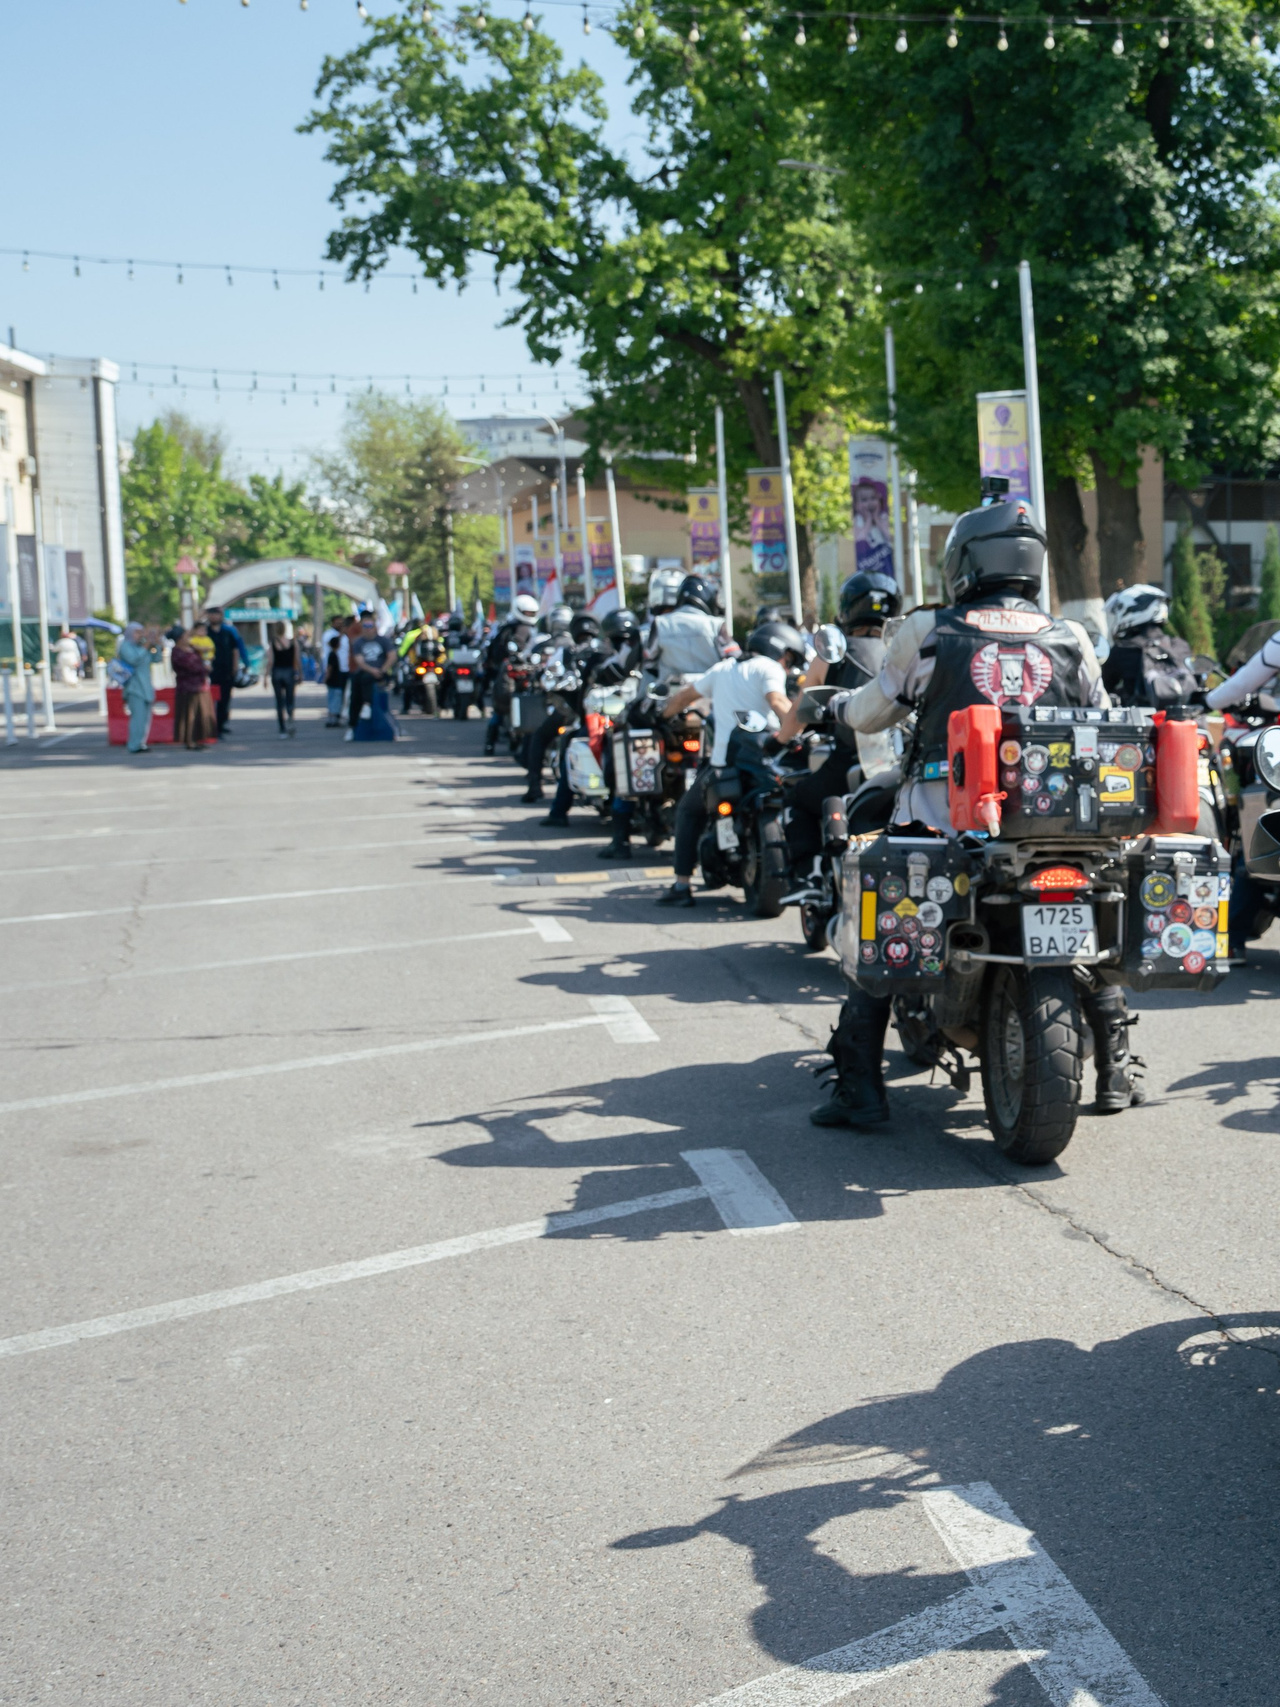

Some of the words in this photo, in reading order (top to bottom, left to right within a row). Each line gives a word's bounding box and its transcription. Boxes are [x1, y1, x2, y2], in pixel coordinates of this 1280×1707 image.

[757, 552, 785, 571] 70
[1034, 907, 1083, 925] 1725
[1030, 936, 1060, 954] BA
[1067, 936, 1091, 954] 24
